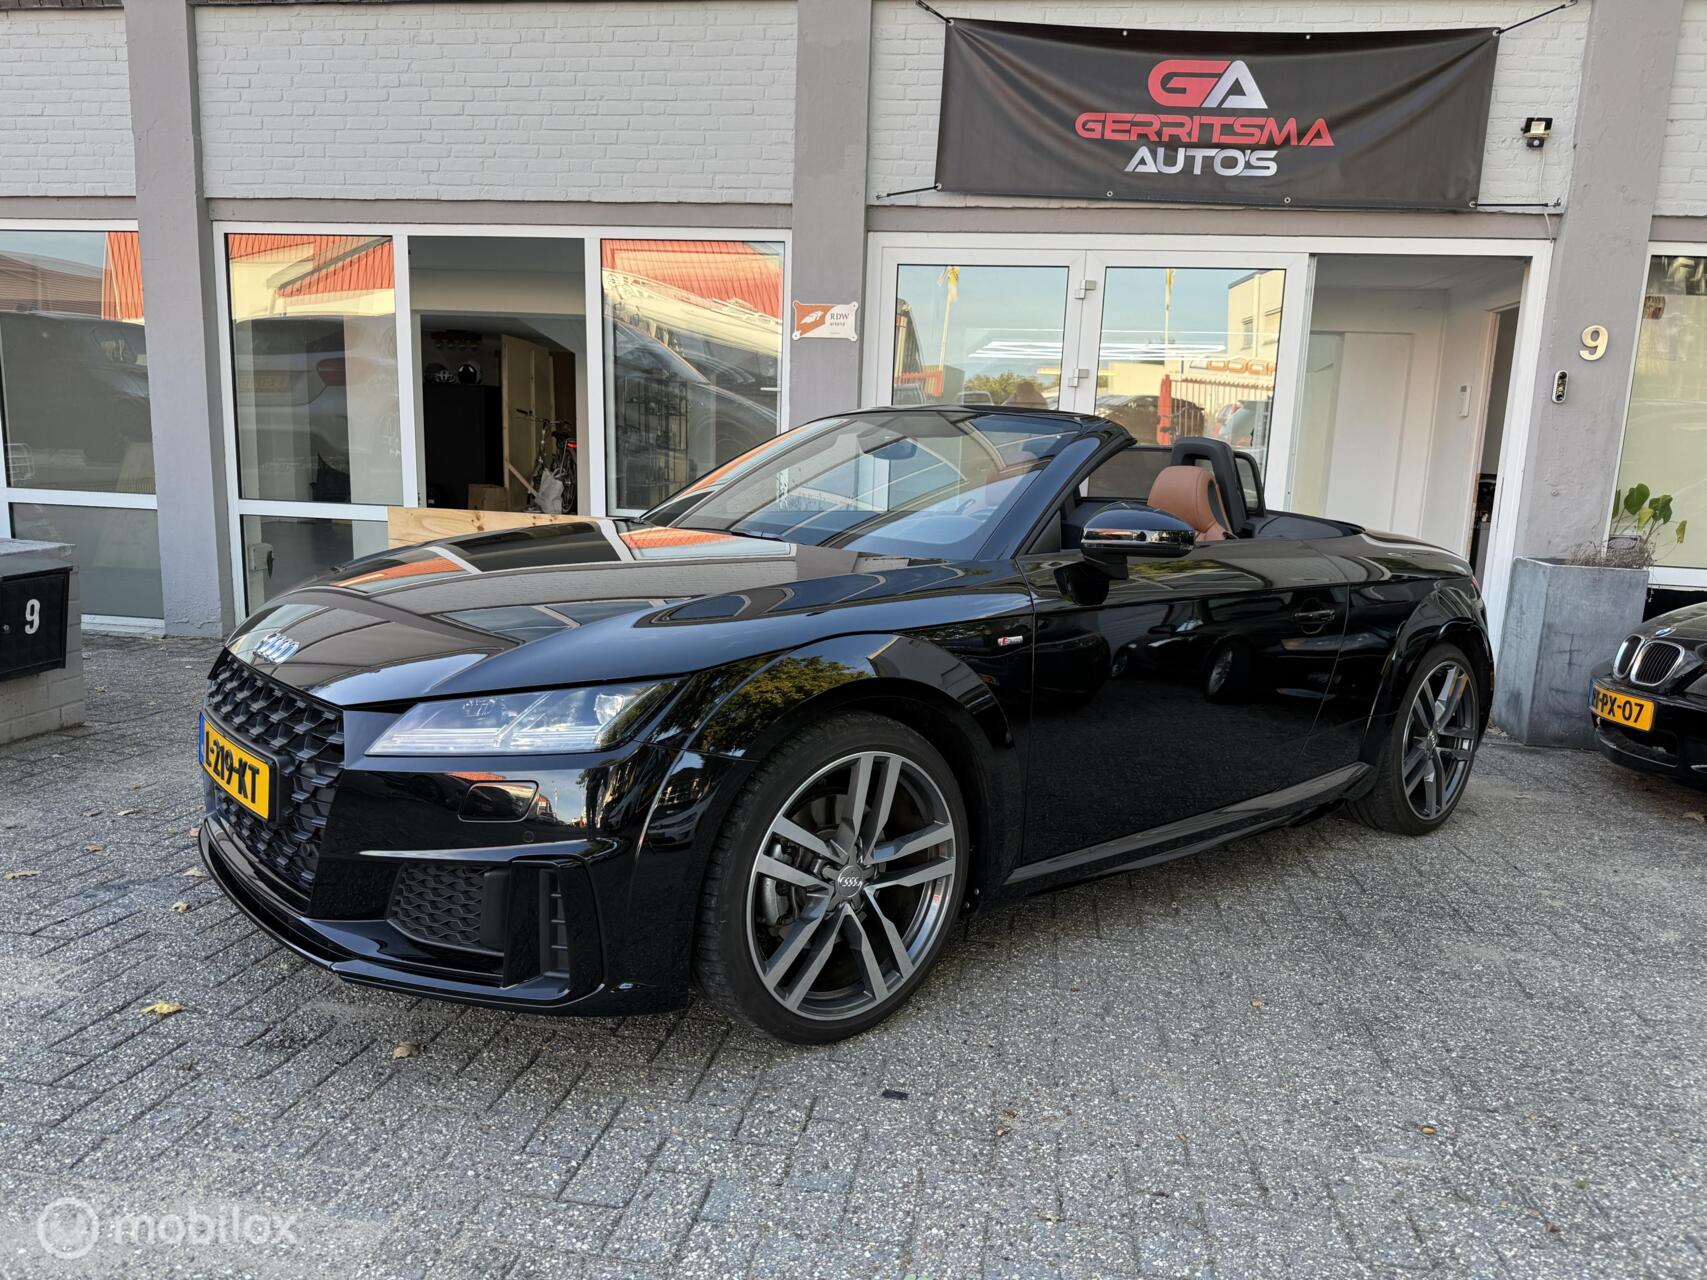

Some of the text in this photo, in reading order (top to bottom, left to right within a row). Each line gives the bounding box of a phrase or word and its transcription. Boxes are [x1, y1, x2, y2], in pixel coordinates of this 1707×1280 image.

[1147, 59, 1268, 110] GA
[1075, 112, 1334, 148] GERRITSMA
[1124, 148, 1278, 177] AUTO'S
[1579, 324, 1609, 361] 9
[24, 598, 41, 635] 9
[1593, 688, 1645, 723] T-PX-07
[205, 731, 259, 804] L-219-KT
